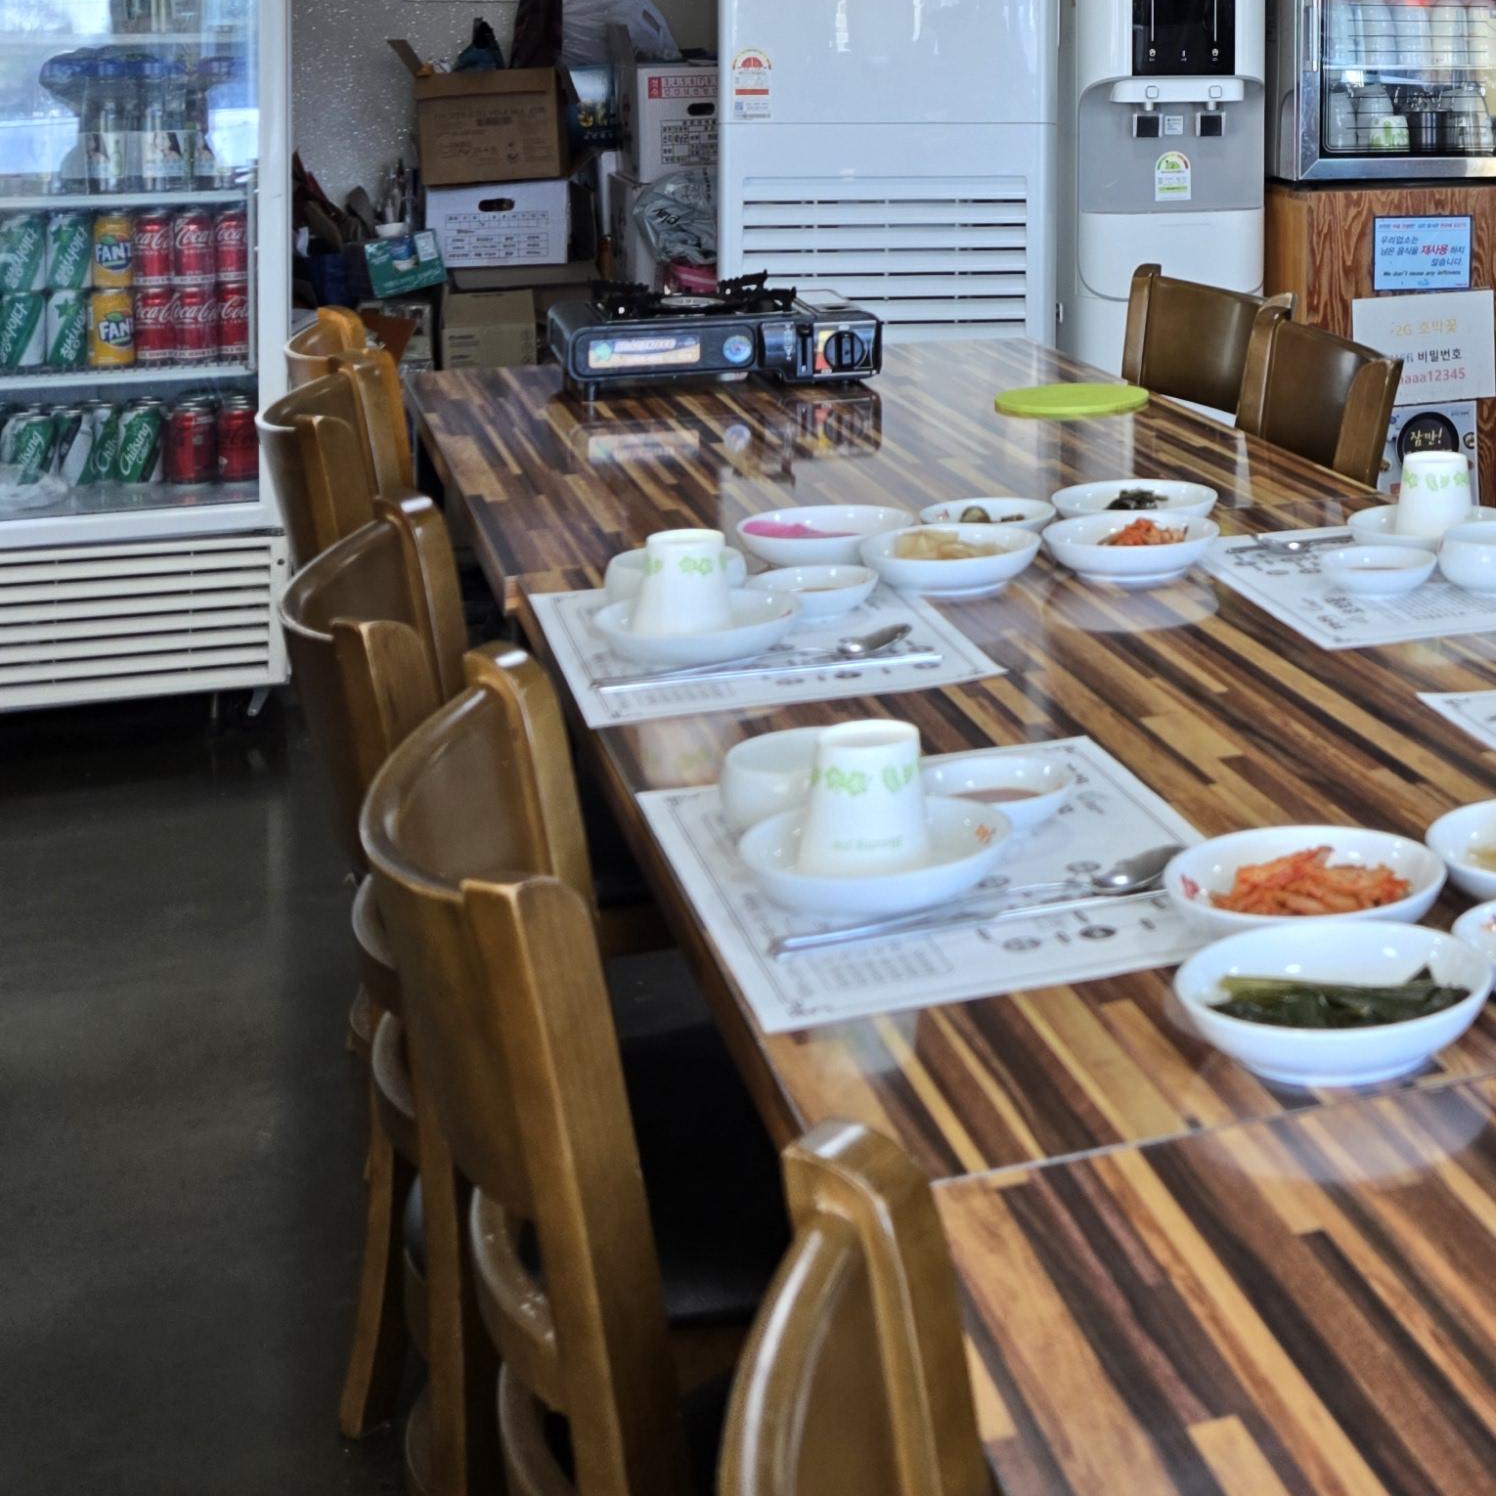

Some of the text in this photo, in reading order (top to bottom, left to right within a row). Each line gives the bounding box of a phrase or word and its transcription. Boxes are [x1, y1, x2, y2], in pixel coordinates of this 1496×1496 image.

[1381, 235, 1419, 245] 우리업소는
[95, 241, 132, 262] FANT
[1380, 243, 1466, 256] 남은 음식을 재사용 하지
[1418, 348, 1462, 363] 비밀번호
[119, 423, 151, 476] Chilsung
